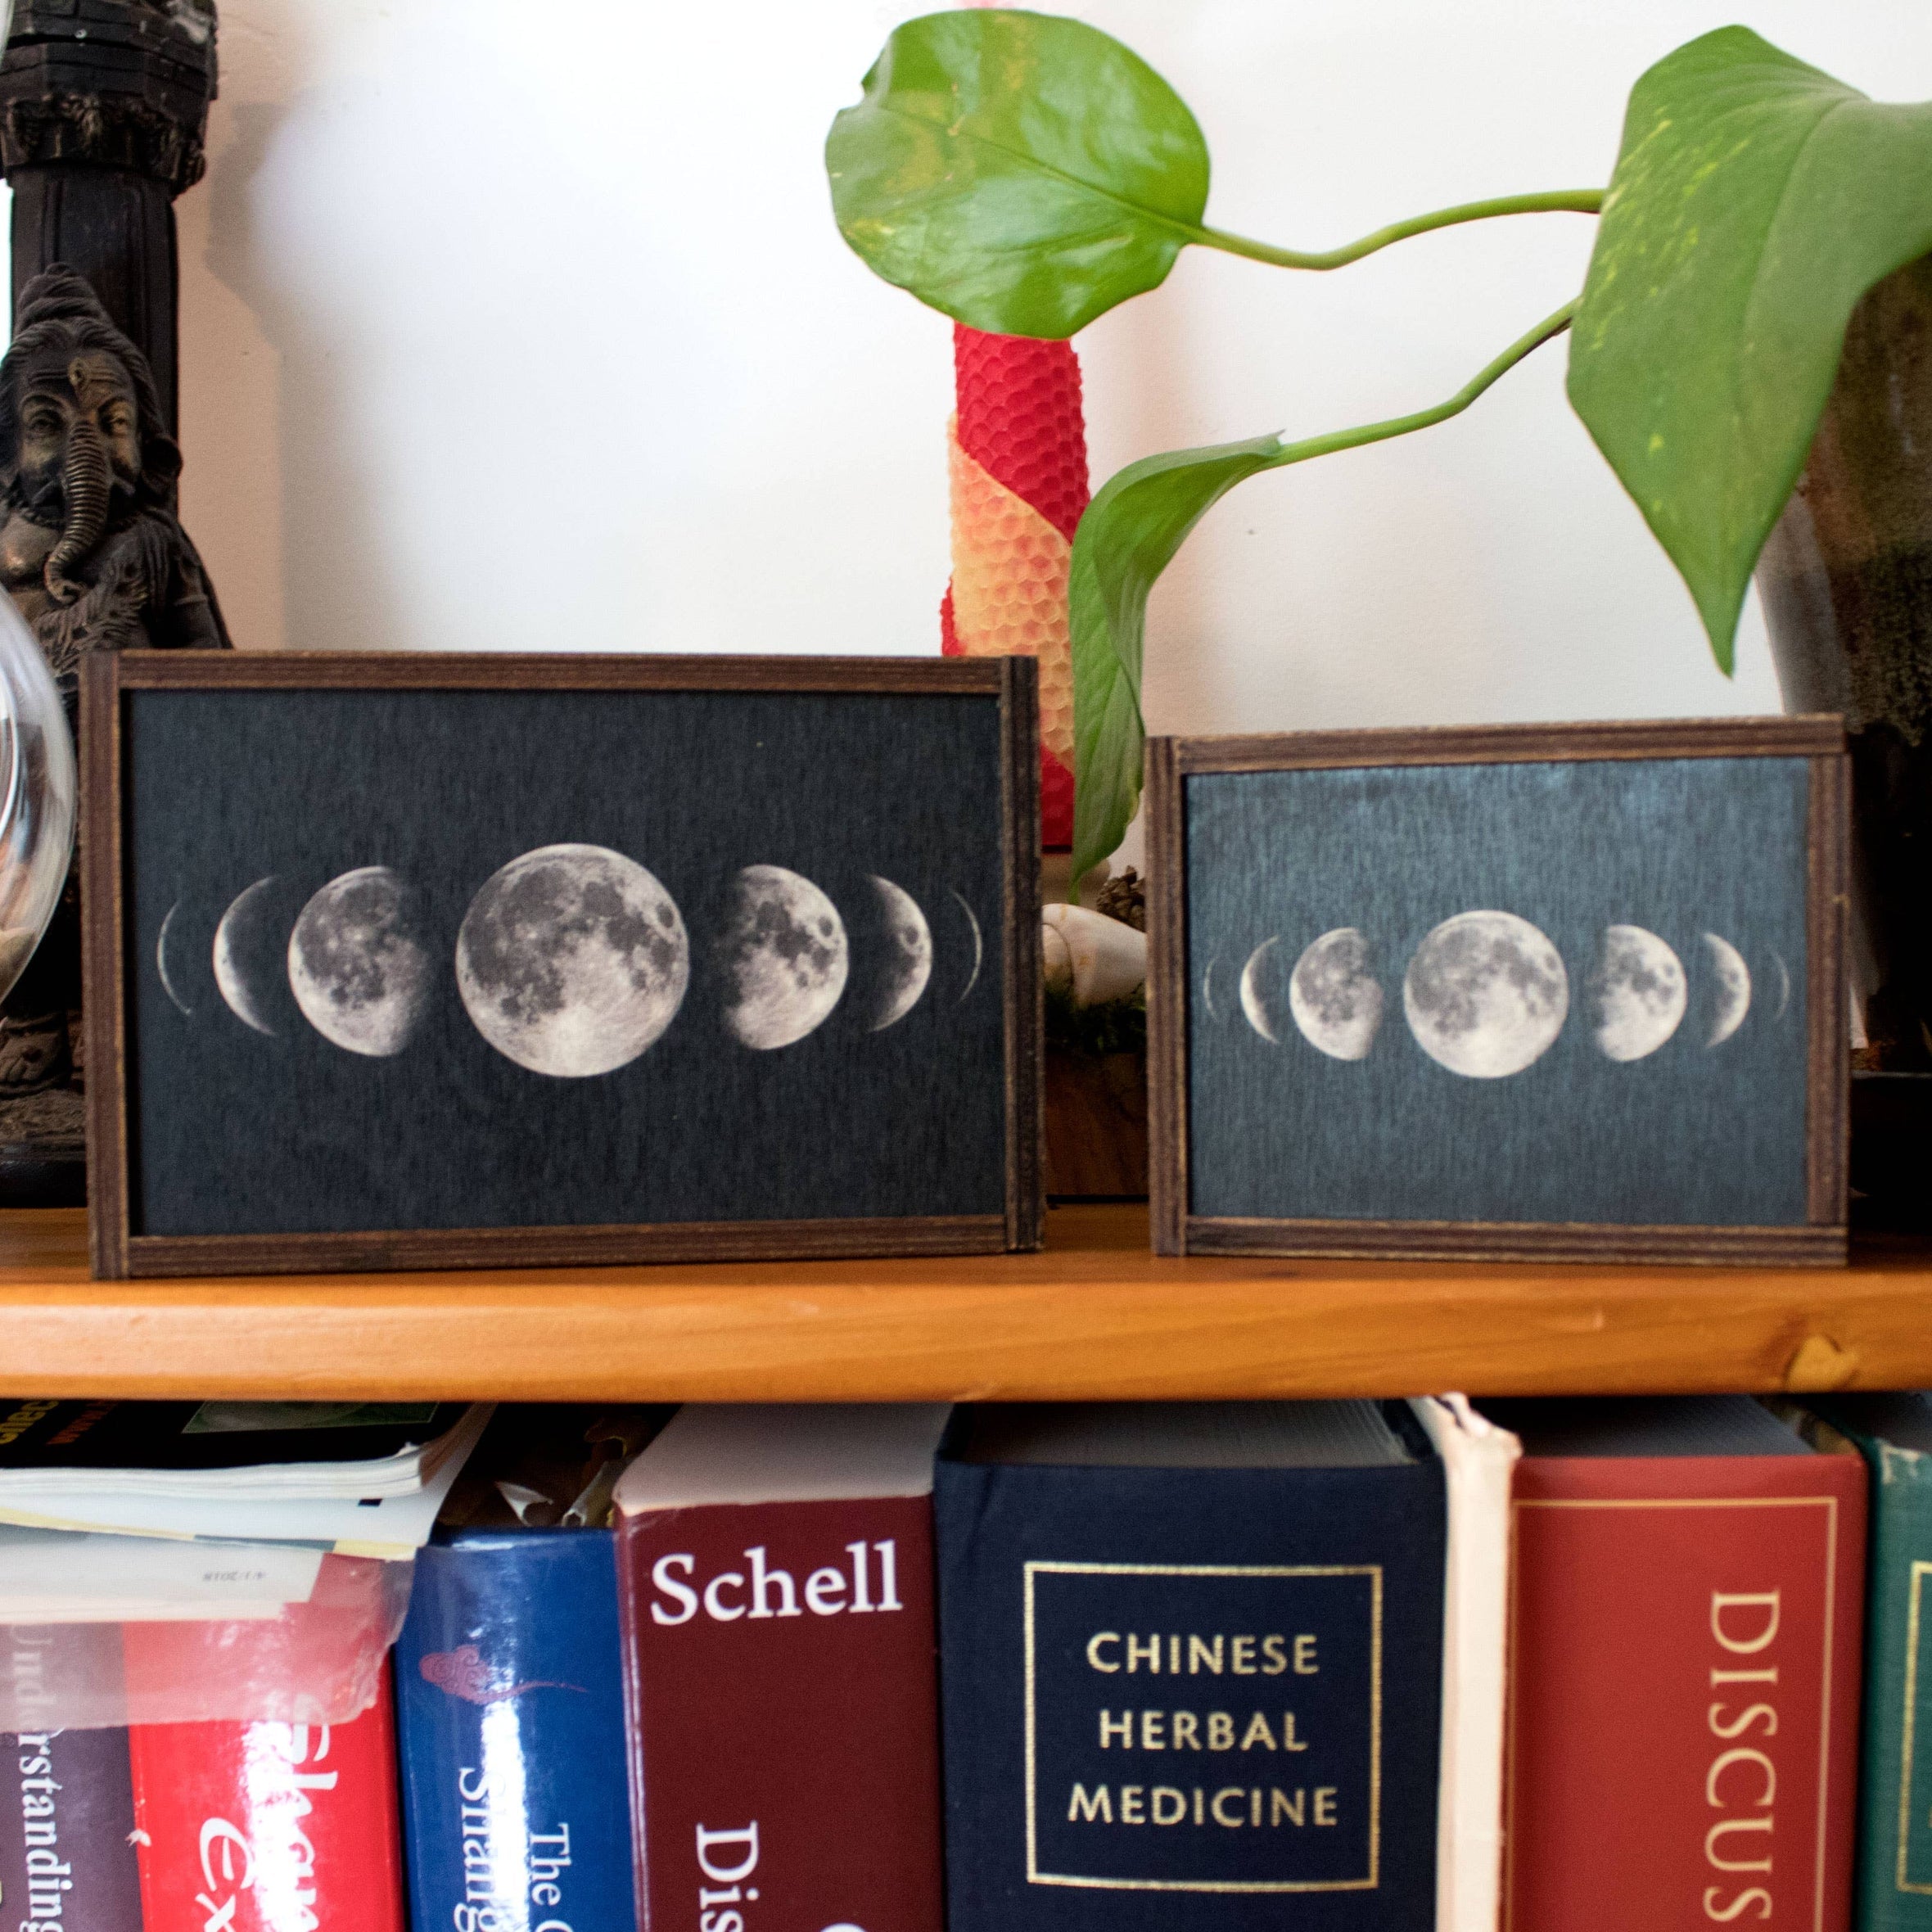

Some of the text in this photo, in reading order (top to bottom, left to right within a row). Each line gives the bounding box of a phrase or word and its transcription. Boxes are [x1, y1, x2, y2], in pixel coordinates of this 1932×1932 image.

[651, 1540, 903, 1625] Schell
[1086, 1632, 1320, 1675] CHINESE
[1099, 1709, 1309, 1751] HERBAL
[1703, 1588, 1780, 1923] DISCUS
[1068, 1783, 1338, 1827] MEDICINE
[529, 1821, 572, 1907] The
[696, 1820, 760, 1932] Dis
